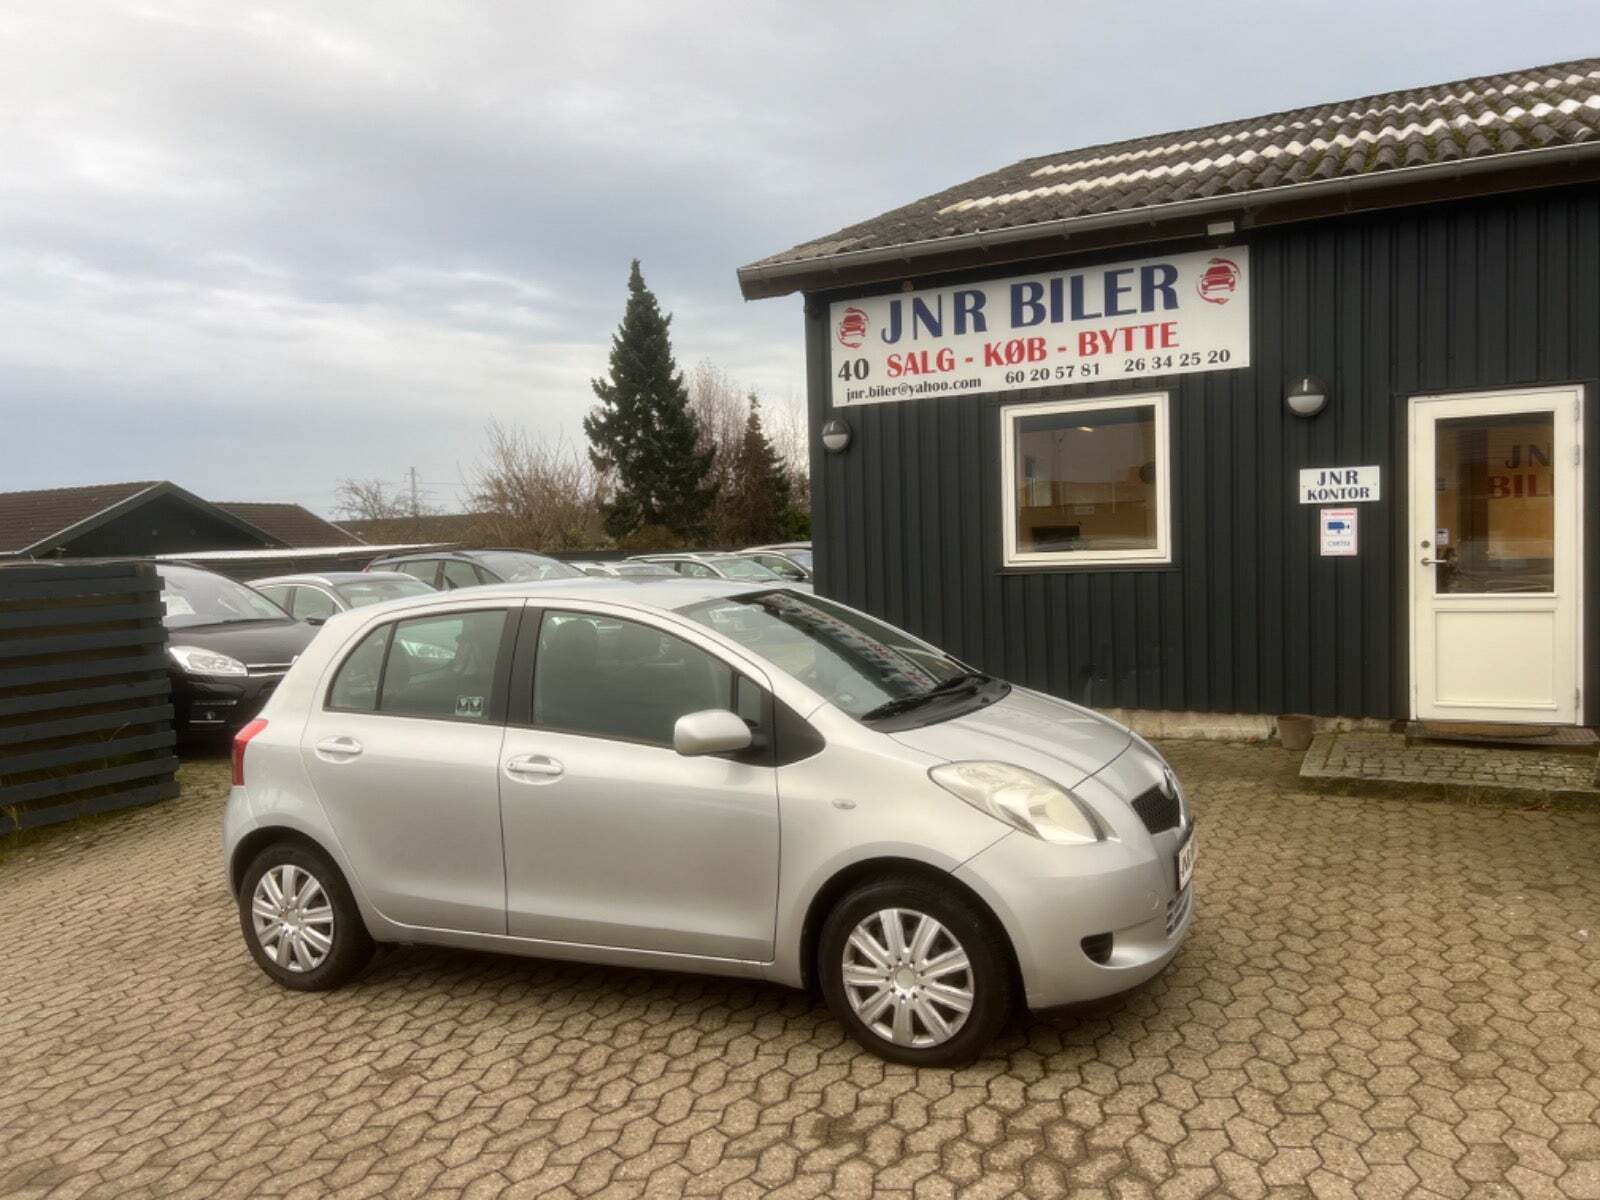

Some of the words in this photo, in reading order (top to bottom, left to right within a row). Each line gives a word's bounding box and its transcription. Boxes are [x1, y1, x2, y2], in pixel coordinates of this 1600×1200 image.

[881, 290, 987, 344] JNR
[1010, 264, 1179, 328] BILER
[886, 347, 955, 378] SALG
[984, 337, 1047, 367] KØB
[1078, 321, 1180, 357] BYTTE
[1124, 358, 1145, 372] 26
[1152, 356, 1172, 370] 34
[1180, 352, 1200, 367] 25
[1208, 349, 1230, 364] 20
[838, 358, 870, 381] 40
[1005, 371, 1024, 384] 60
[1030, 368, 1049, 382] 20
[1055, 366, 1074, 380] 57
[1081, 363, 1100, 377] 81
[846, 377, 981, 402] jnr.biler@yahoo.com
[1317, 470, 1358, 486] JNR
[1488, 474, 1554, 499] BIL
[1308, 487, 1369, 500] KONTOR
